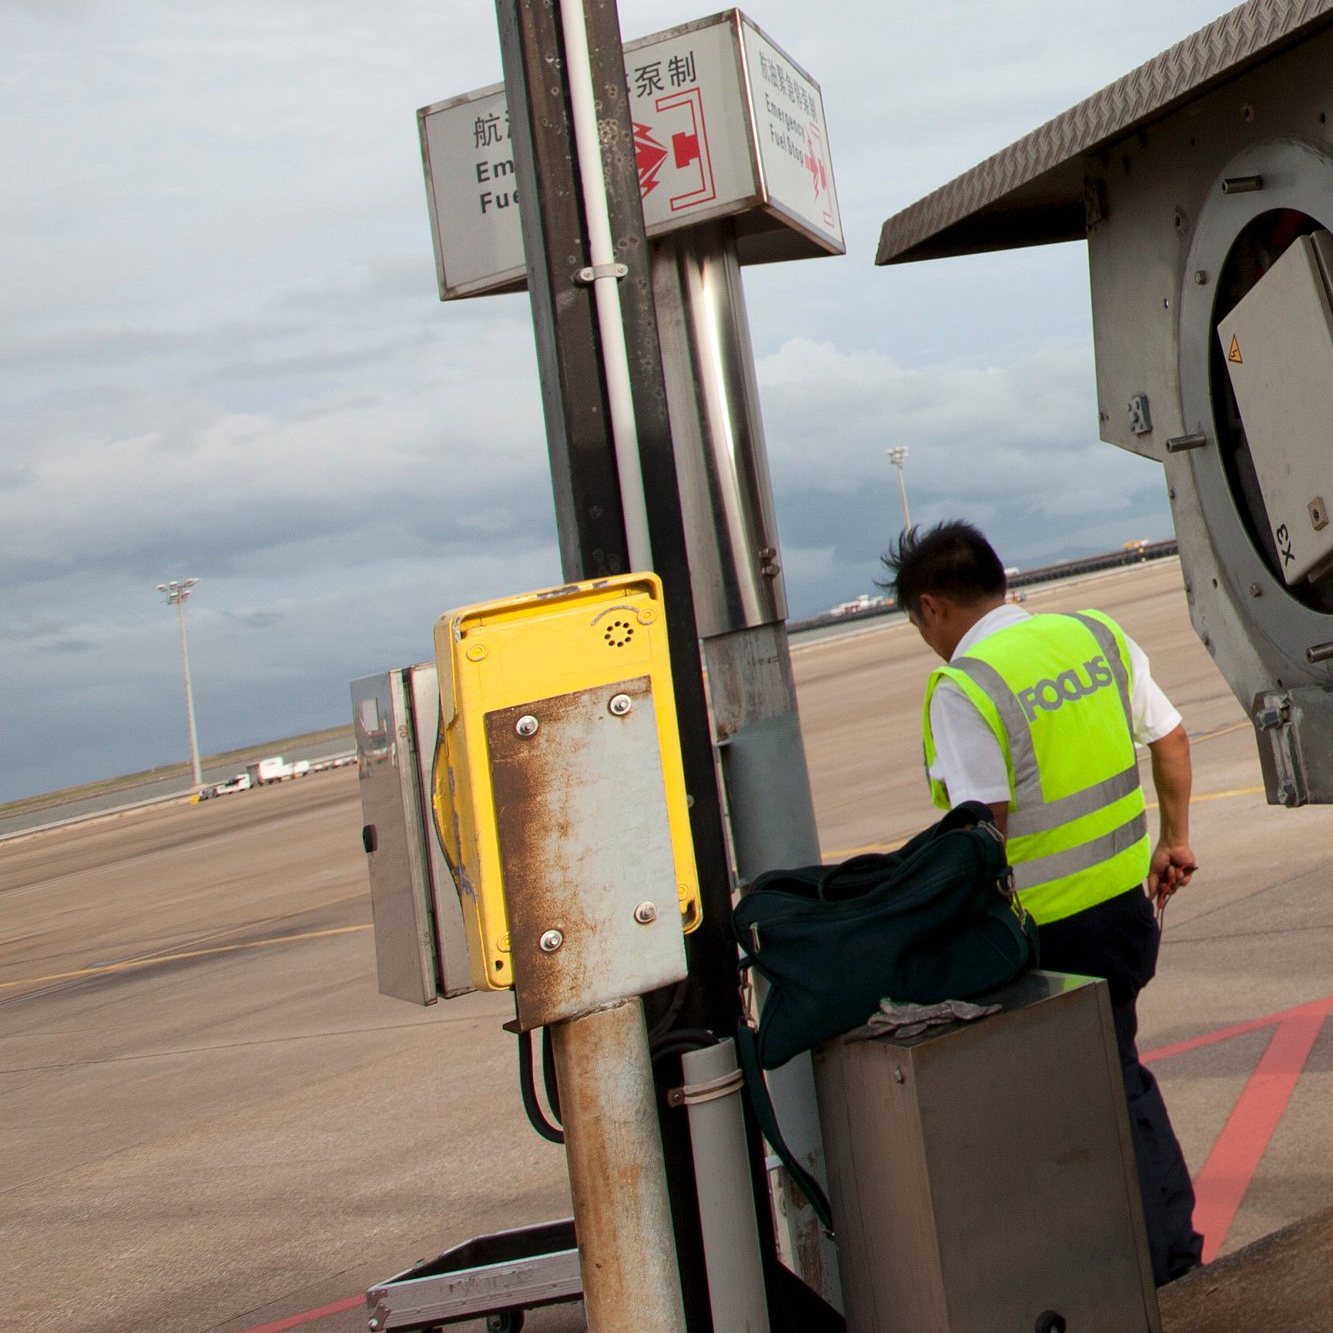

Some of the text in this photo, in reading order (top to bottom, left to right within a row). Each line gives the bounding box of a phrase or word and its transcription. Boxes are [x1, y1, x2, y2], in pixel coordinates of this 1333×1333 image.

[473, 50, 697, 149] 航 泵制
[765, 93, 805, 143] Emergency
[770, 123, 804, 170] Fuel Stop
[1017, 655, 1113, 723] FOCUS
